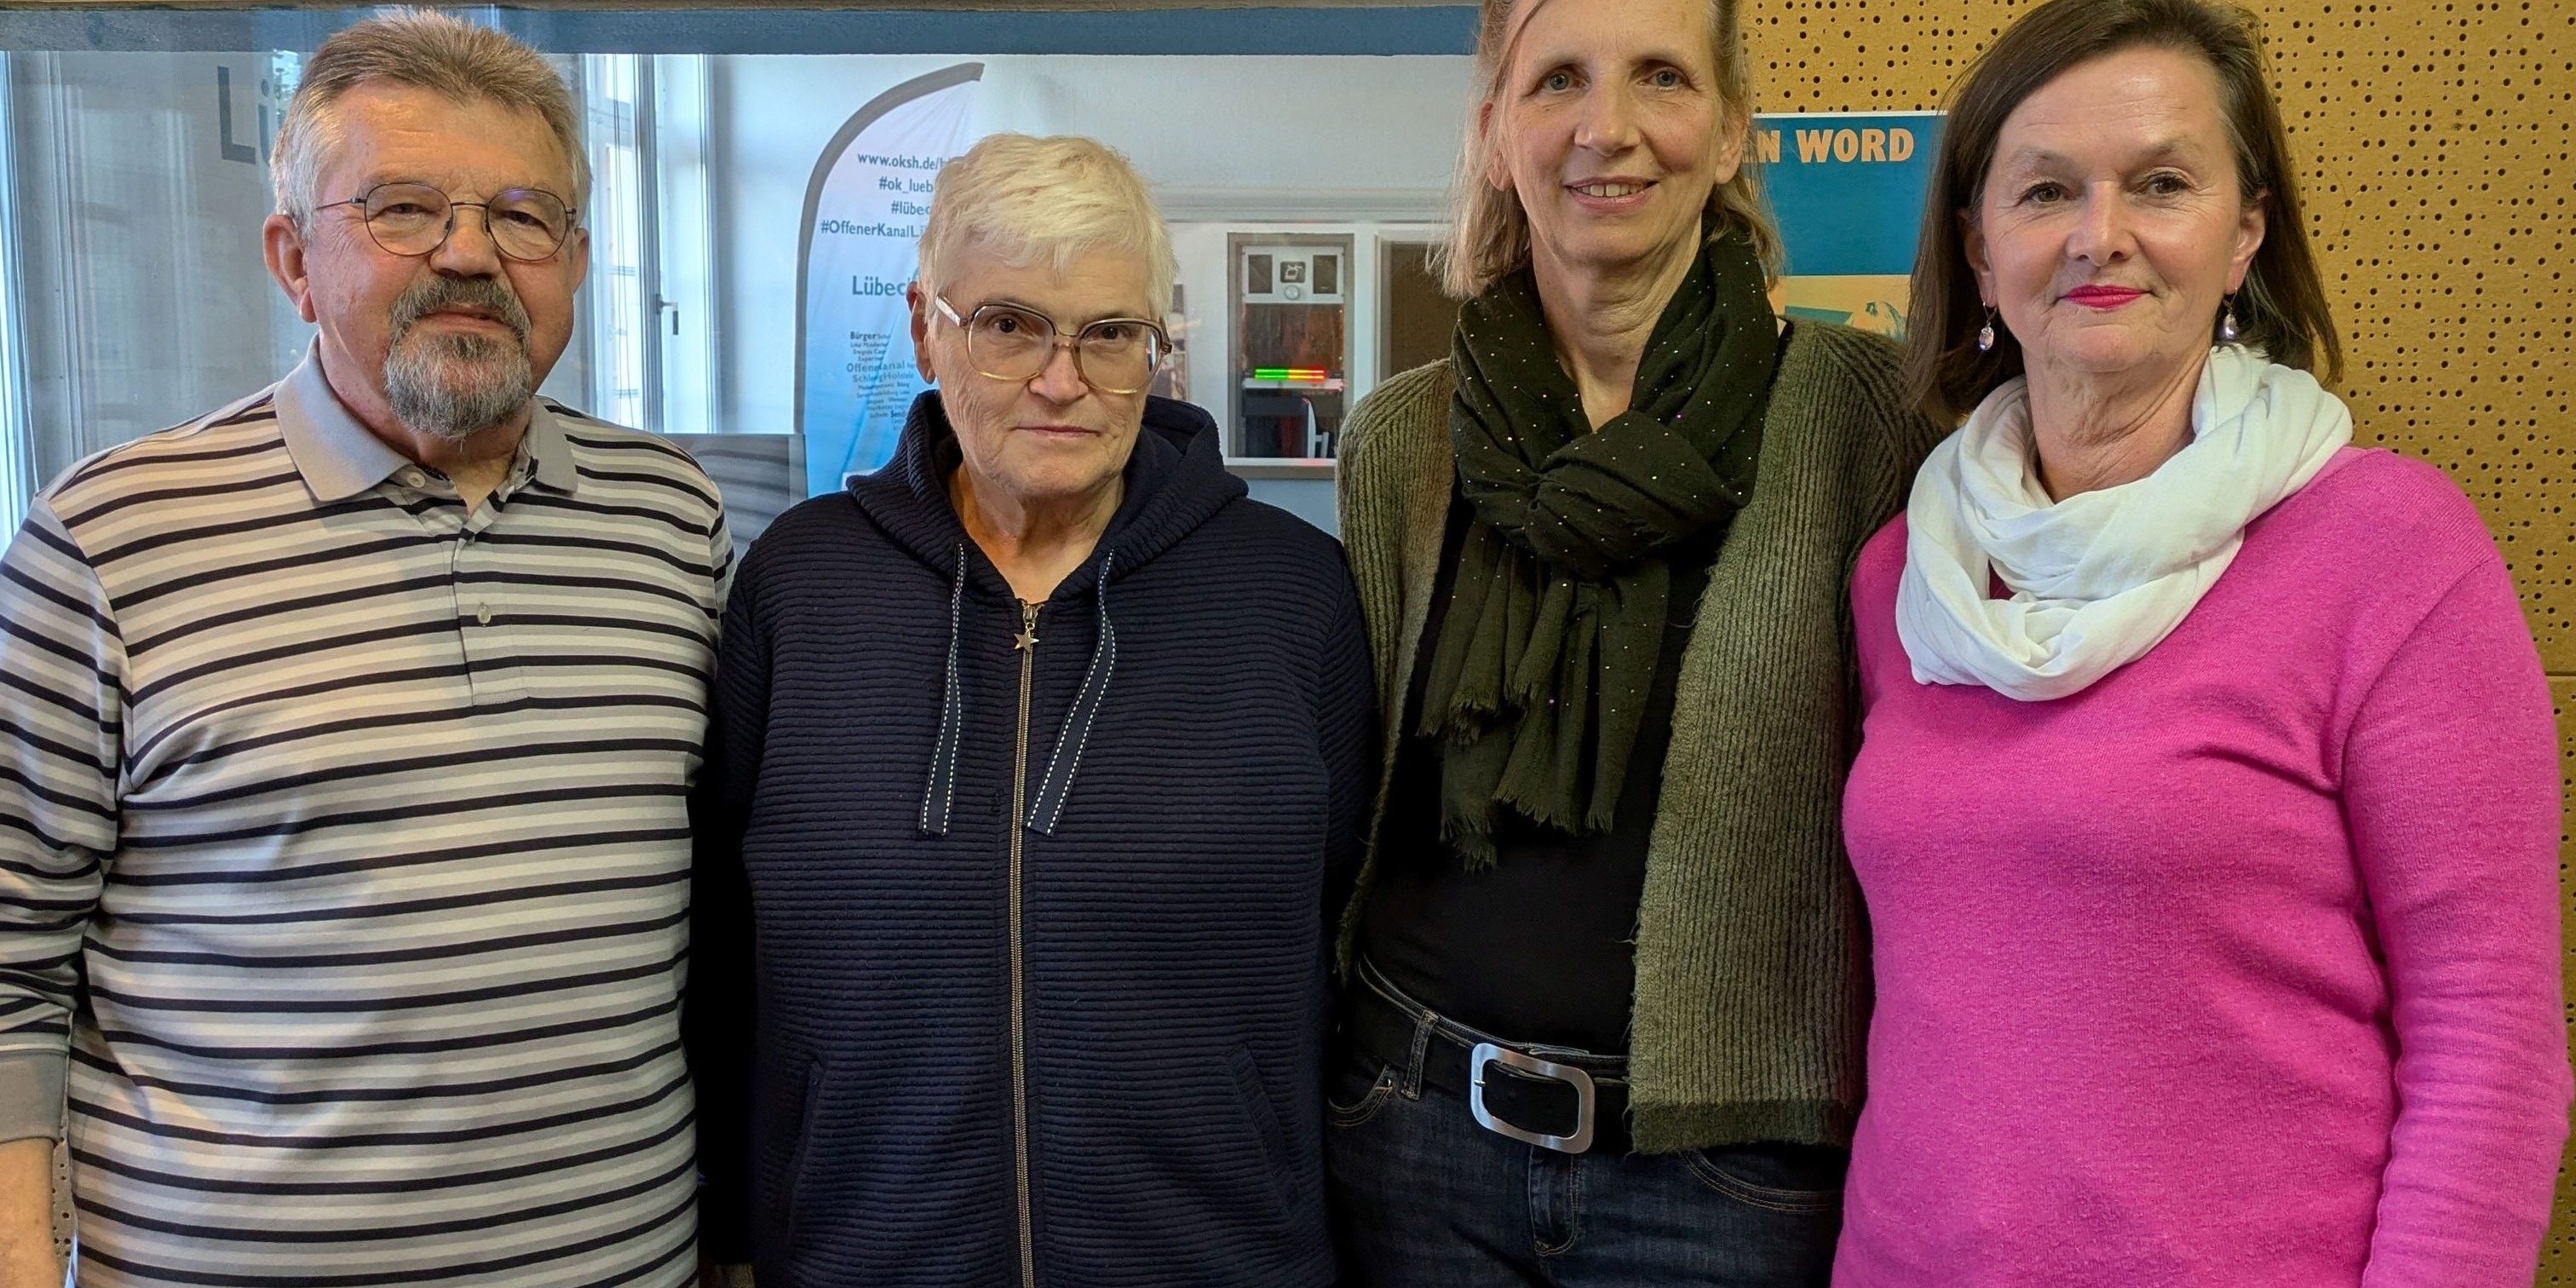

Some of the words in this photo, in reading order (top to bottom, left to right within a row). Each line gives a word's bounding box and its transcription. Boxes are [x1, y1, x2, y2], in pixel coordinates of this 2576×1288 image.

[1796, 128, 1914, 164] WORD
[879, 175, 934, 194] #ok_lueb
[891, 200, 931, 216] #lübec
[853, 275, 911, 296] Lübec
